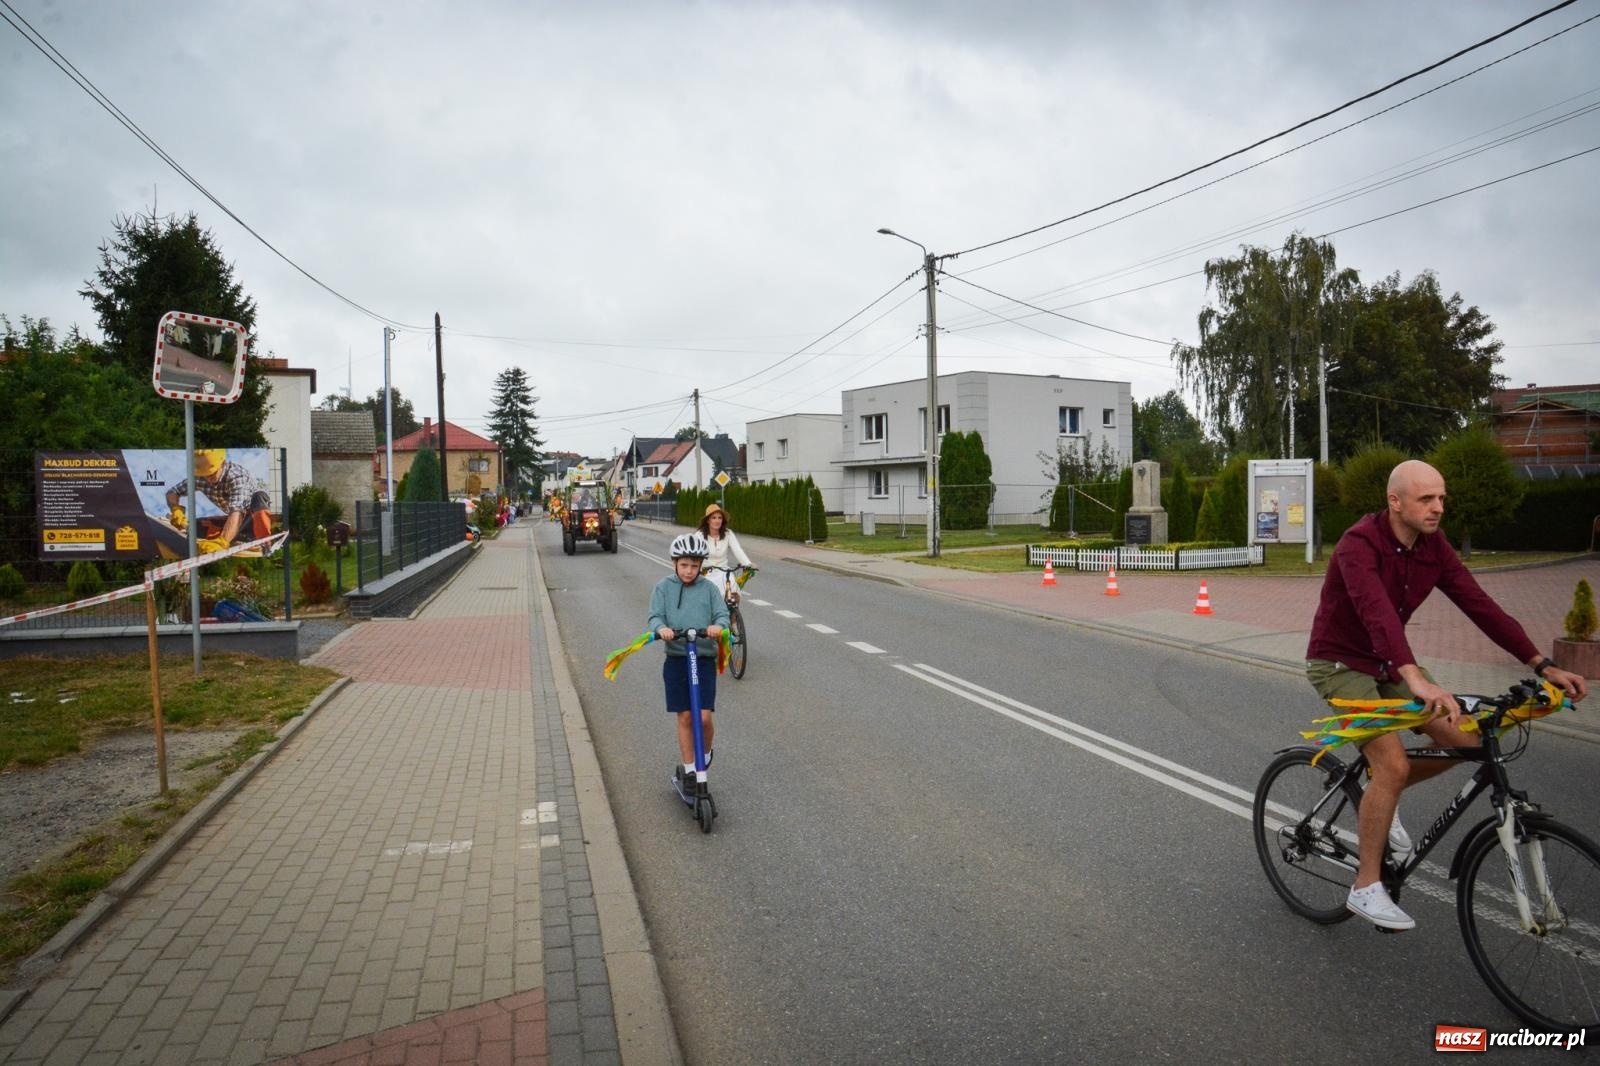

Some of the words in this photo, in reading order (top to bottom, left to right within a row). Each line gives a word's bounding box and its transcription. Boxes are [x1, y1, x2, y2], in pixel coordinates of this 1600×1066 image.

[44, 459, 81, 467] MAXBUD
[83, 459, 117, 467] DEKKER
[146, 470, 157, 480] M
[1414, 790, 1463, 855] UNIBIKE
